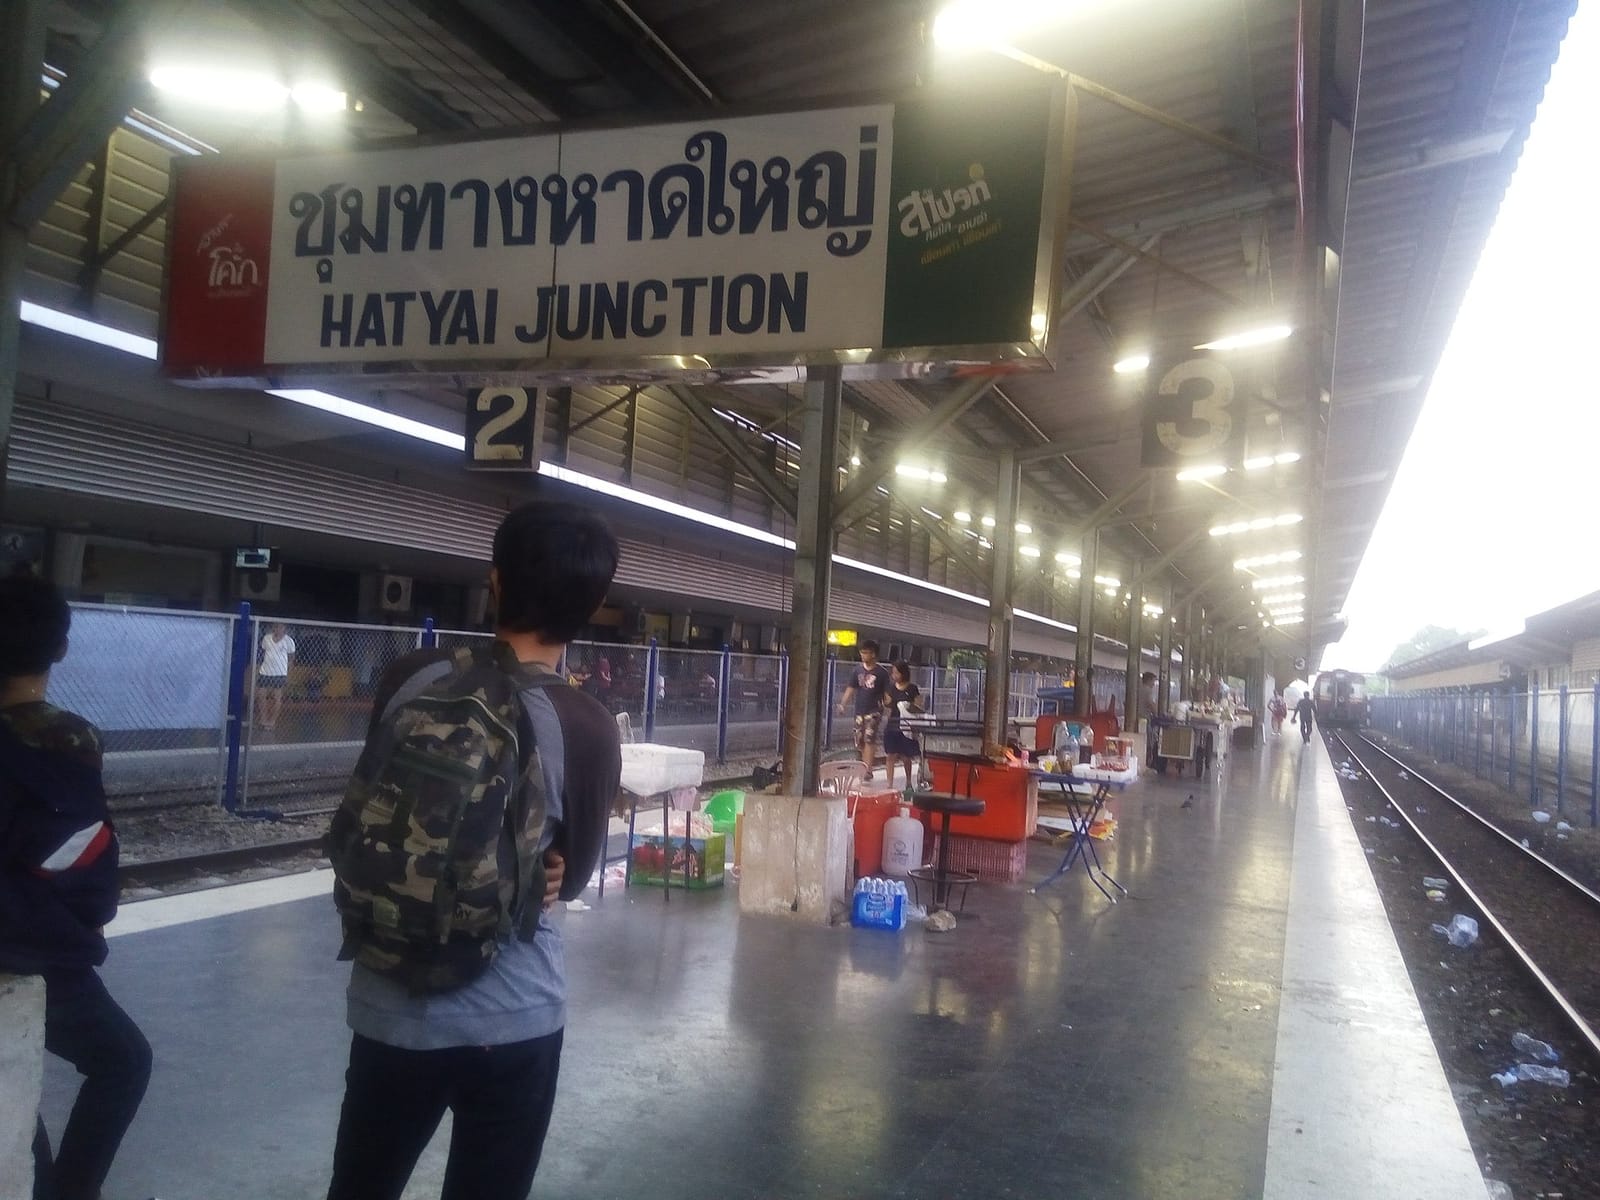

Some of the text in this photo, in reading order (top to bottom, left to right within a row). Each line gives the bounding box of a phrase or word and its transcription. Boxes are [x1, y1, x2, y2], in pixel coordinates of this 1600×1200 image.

[289, 125, 879, 284] ชุมทางหาดใหญ่
[320, 271, 808, 348] HATYAI JUNCTION
[474, 386, 528, 460] 2
[1156, 359, 1234, 456] 3
